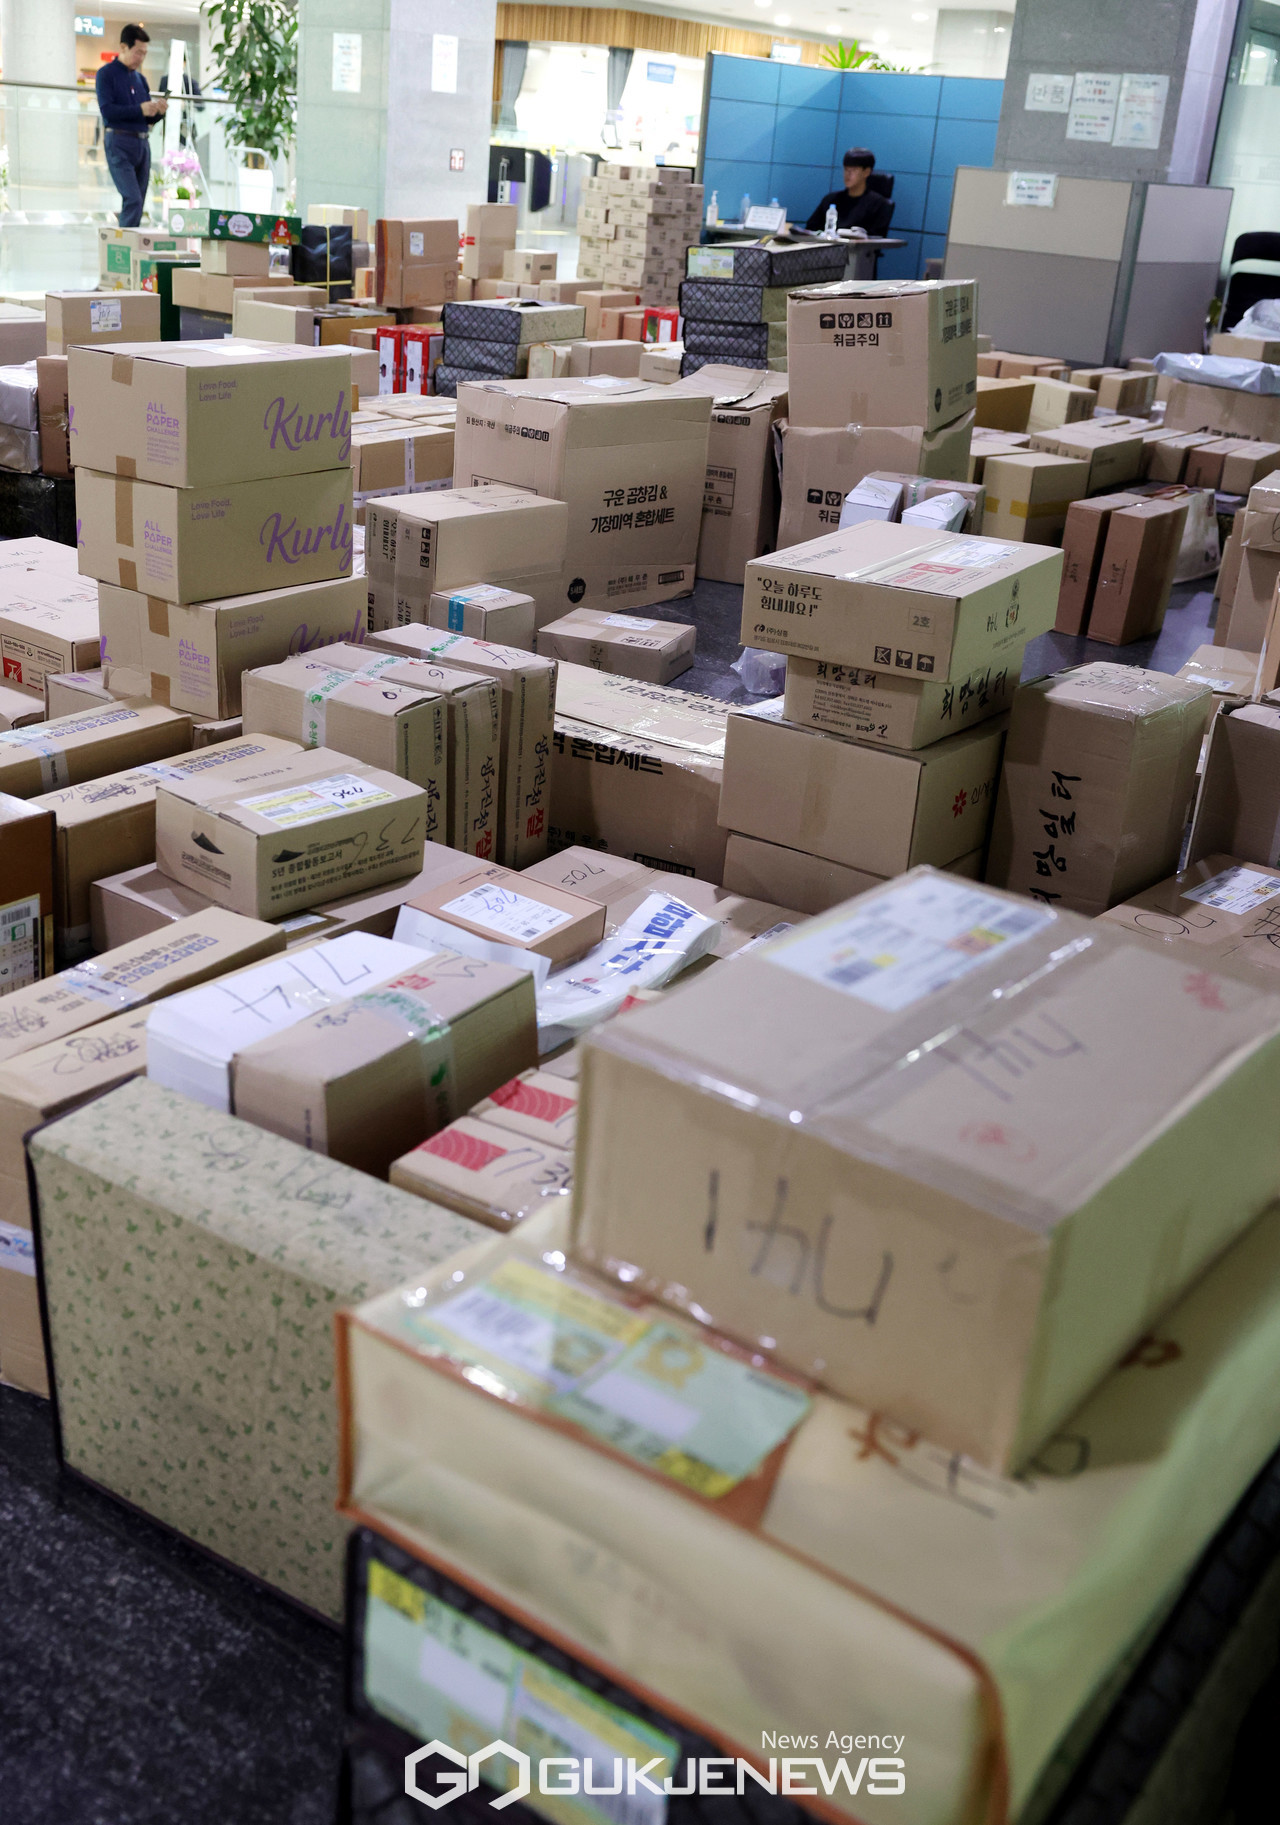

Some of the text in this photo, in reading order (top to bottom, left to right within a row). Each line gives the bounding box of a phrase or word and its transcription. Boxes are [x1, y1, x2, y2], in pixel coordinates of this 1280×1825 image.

[833, 332, 880, 347] 취급주의
[199, 382, 217, 391] Love
[199, 391, 232, 402] Love Life
[146, 401, 167, 415] ALL
[146, 413, 180, 430] PAPER
[263, 390, 352, 462] Kurly
[146, 426, 180, 438] CHALLENGE
[602, 484, 668, 509] 구운 곱창김 &
[191, 499, 209, 511] Love
[191, 508, 226, 522] Love Life
[590, 506, 676, 535] 기장미역 혼합세트
[818, 508, 840, 524] 취급
[144, 519, 162, 534] ALL
[143, 532, 173, 548] PAPER
[259, 503, 354, 572] Kurly
[144, 542, 173, 556] CHALLENGE
[756, 576, 823, 601] "오늘 하루도
[229, 619, 246, 630] Love
[912, 614, 931, 629] 2호
[229, 625, 260, 639] Love Life
[178, 638, 198, 653] ALL
[178, 649, 211, 667] PAPER
[178, 660, 211, 675] CHALLENGE
[816, 661, 877, 689] 희망일터
[939, 666, 1009, 721] 희망일터
[561, 863, 606, 887] 705
[214, 948, 373, 1024] 714
